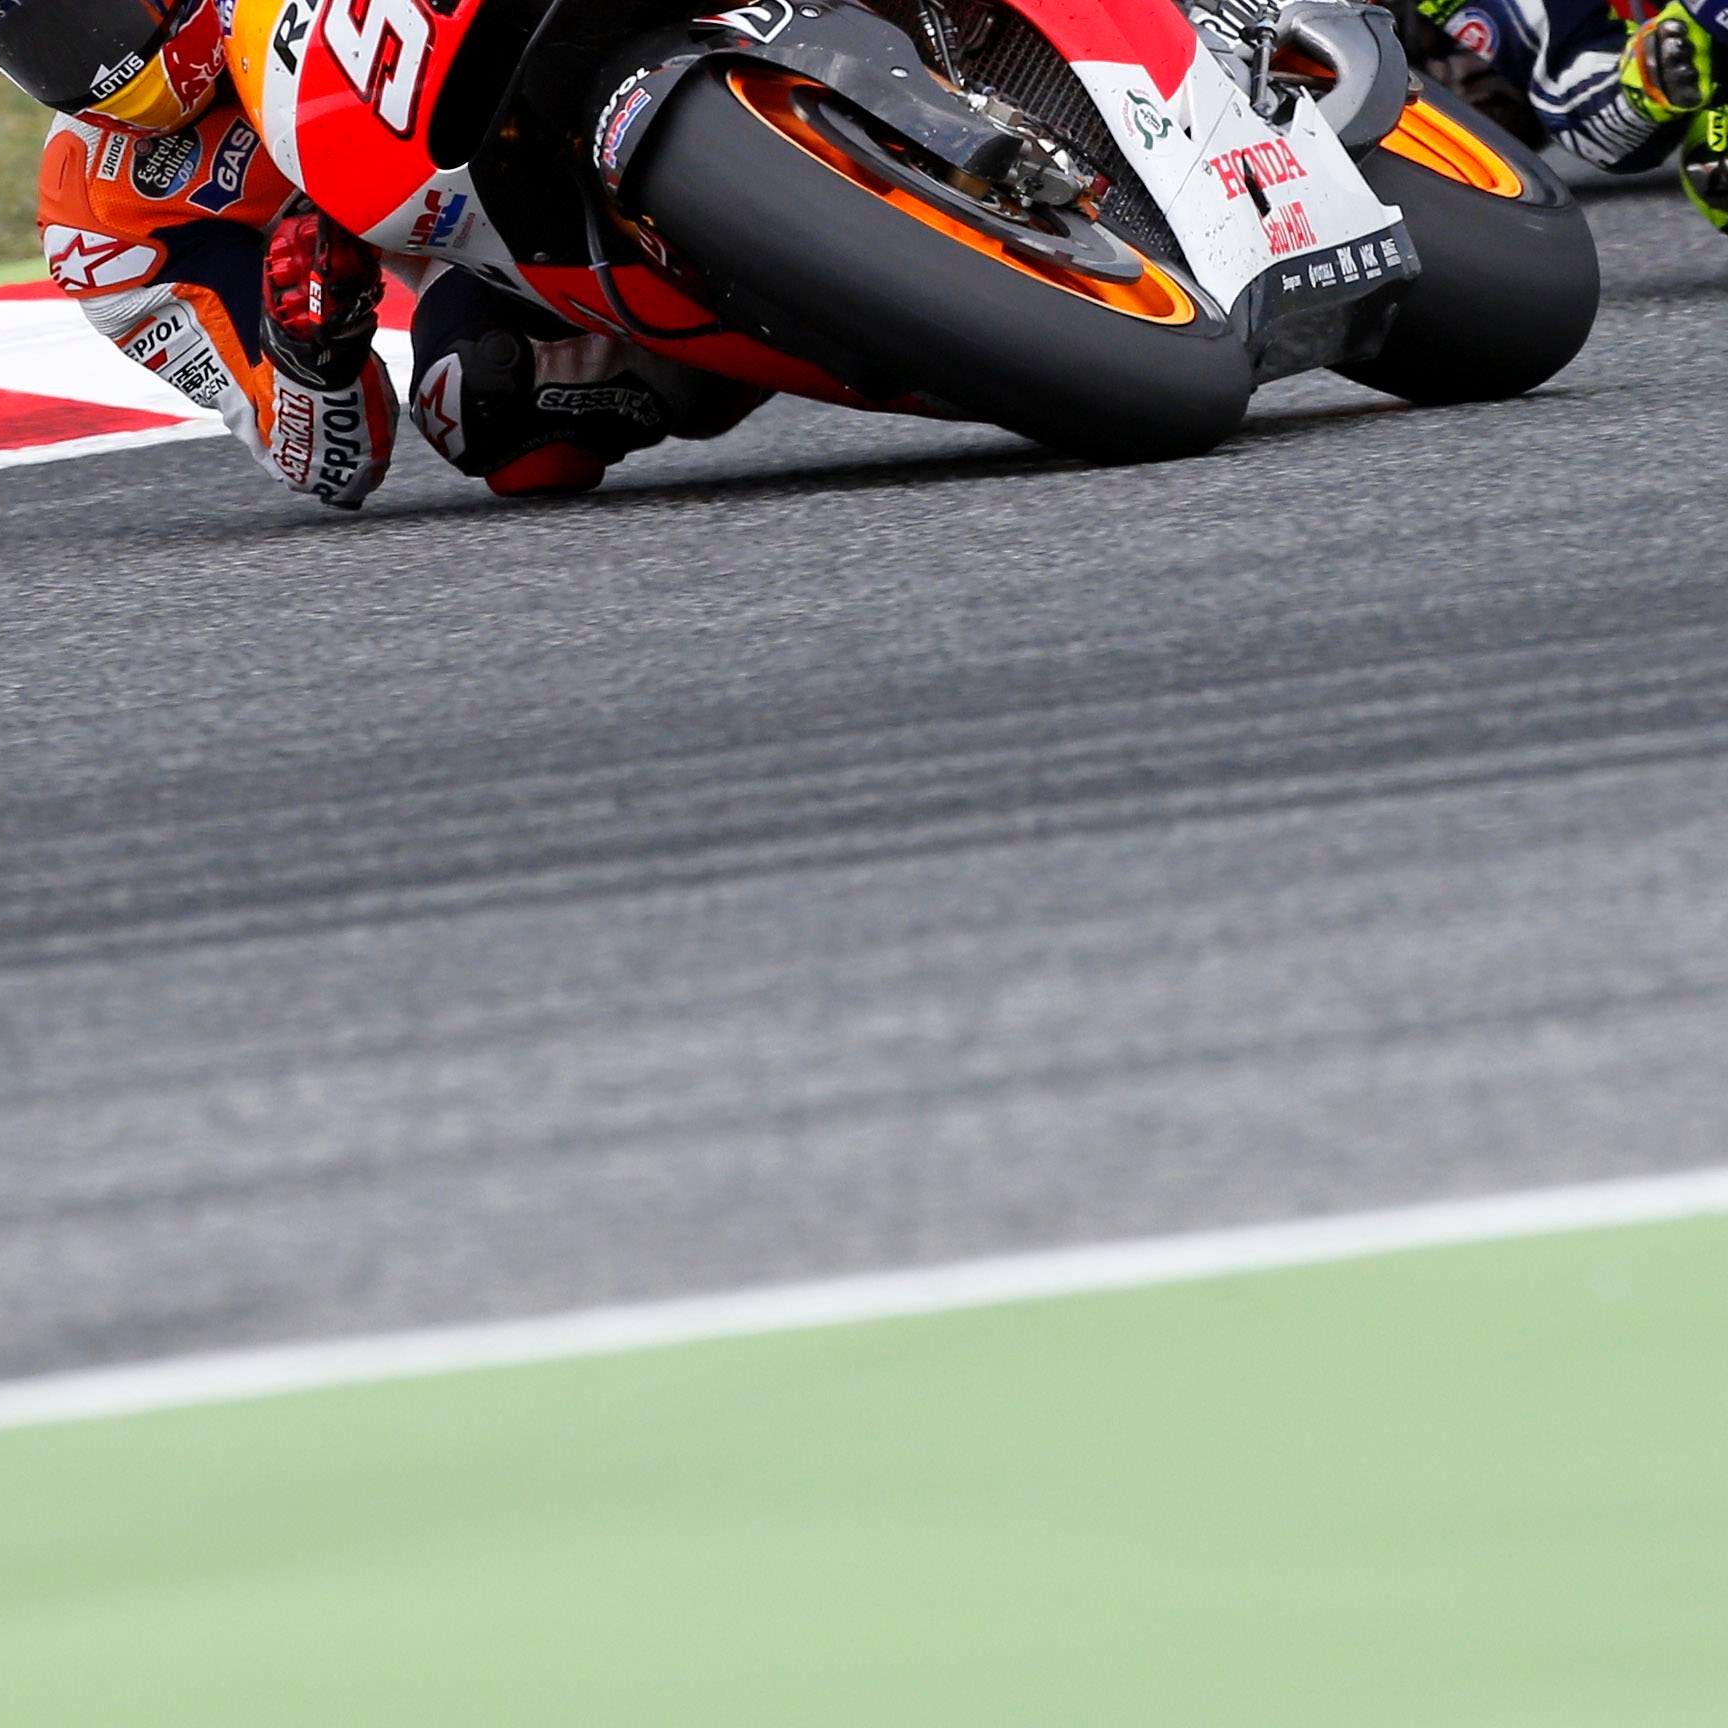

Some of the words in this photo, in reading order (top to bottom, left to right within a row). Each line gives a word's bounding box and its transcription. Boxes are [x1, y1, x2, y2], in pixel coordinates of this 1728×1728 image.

[92, 55, 145, 99] LOTUS
[154, 139, 195, 189] Galicia
[217, 127, 256, 192] GAS
[1209, 138, 1307, 200] HONDA
[312, 391, 362, 507] REPSOL
